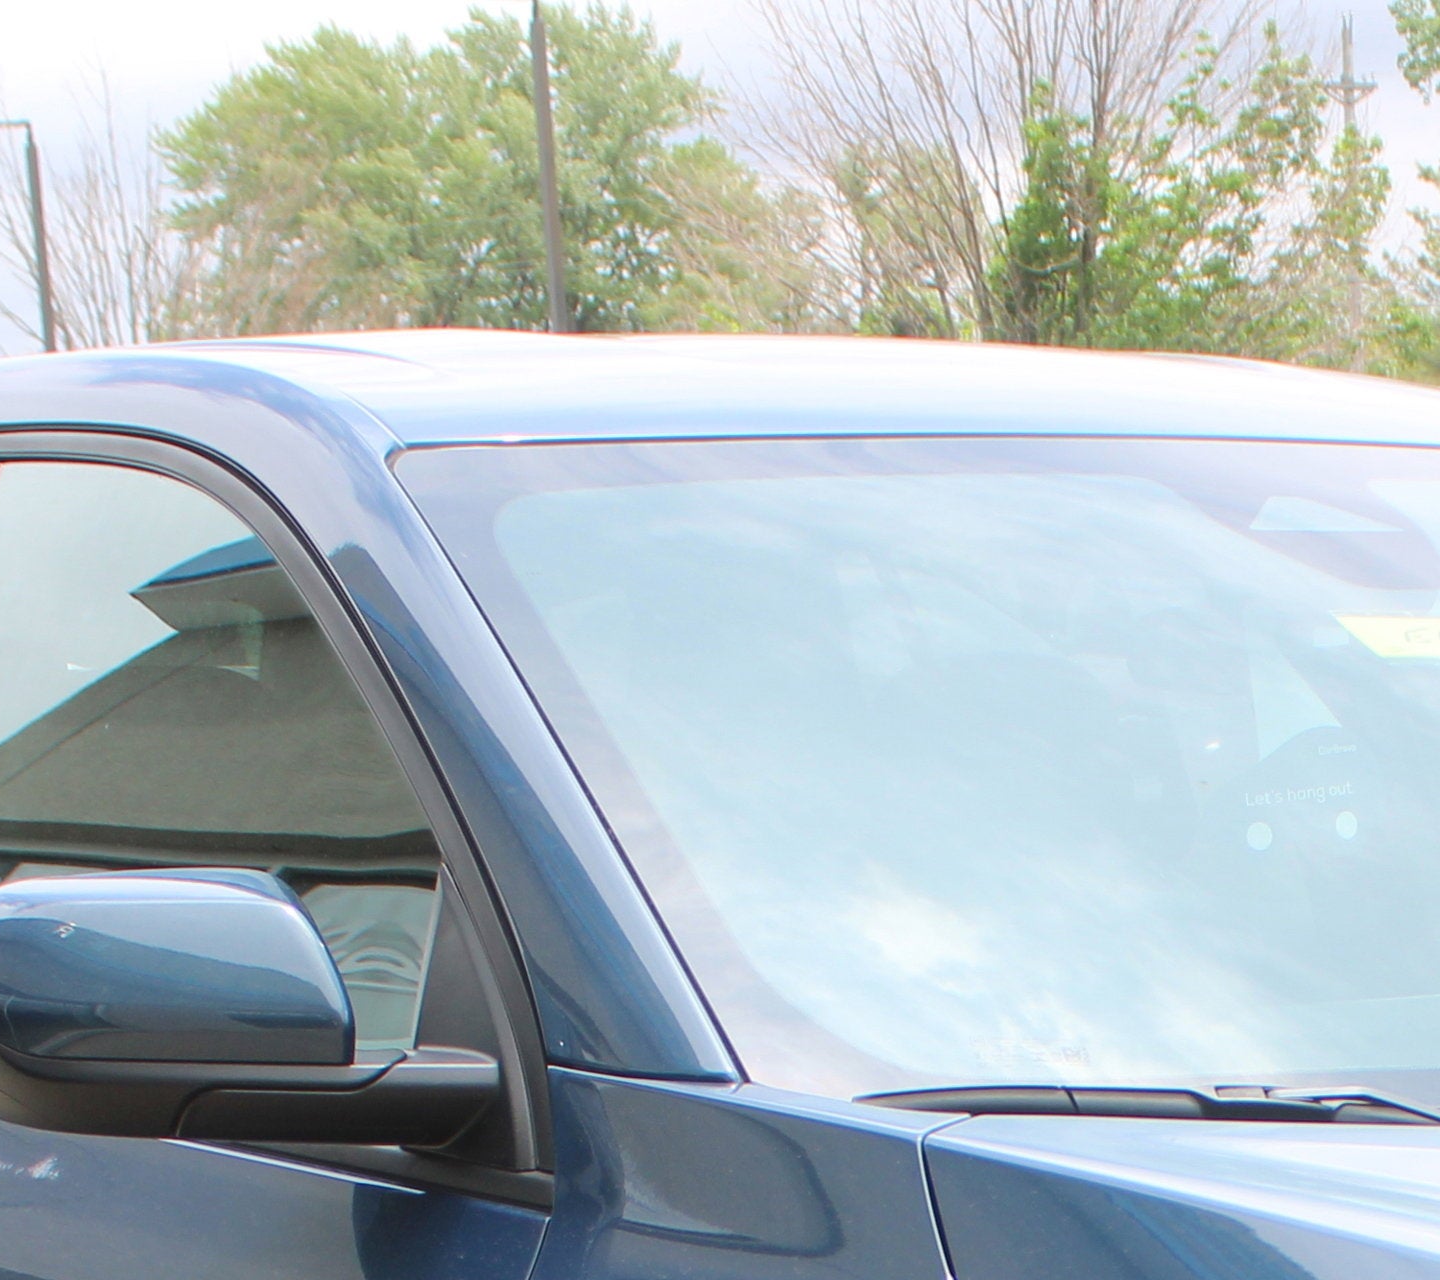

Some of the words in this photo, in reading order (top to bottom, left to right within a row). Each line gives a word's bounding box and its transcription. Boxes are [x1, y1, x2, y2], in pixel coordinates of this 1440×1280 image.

[1245, 791, 1283, 807] Let's
[1287, 785, 1326, 803] hang
[1329, 780, 1354, 796] out
